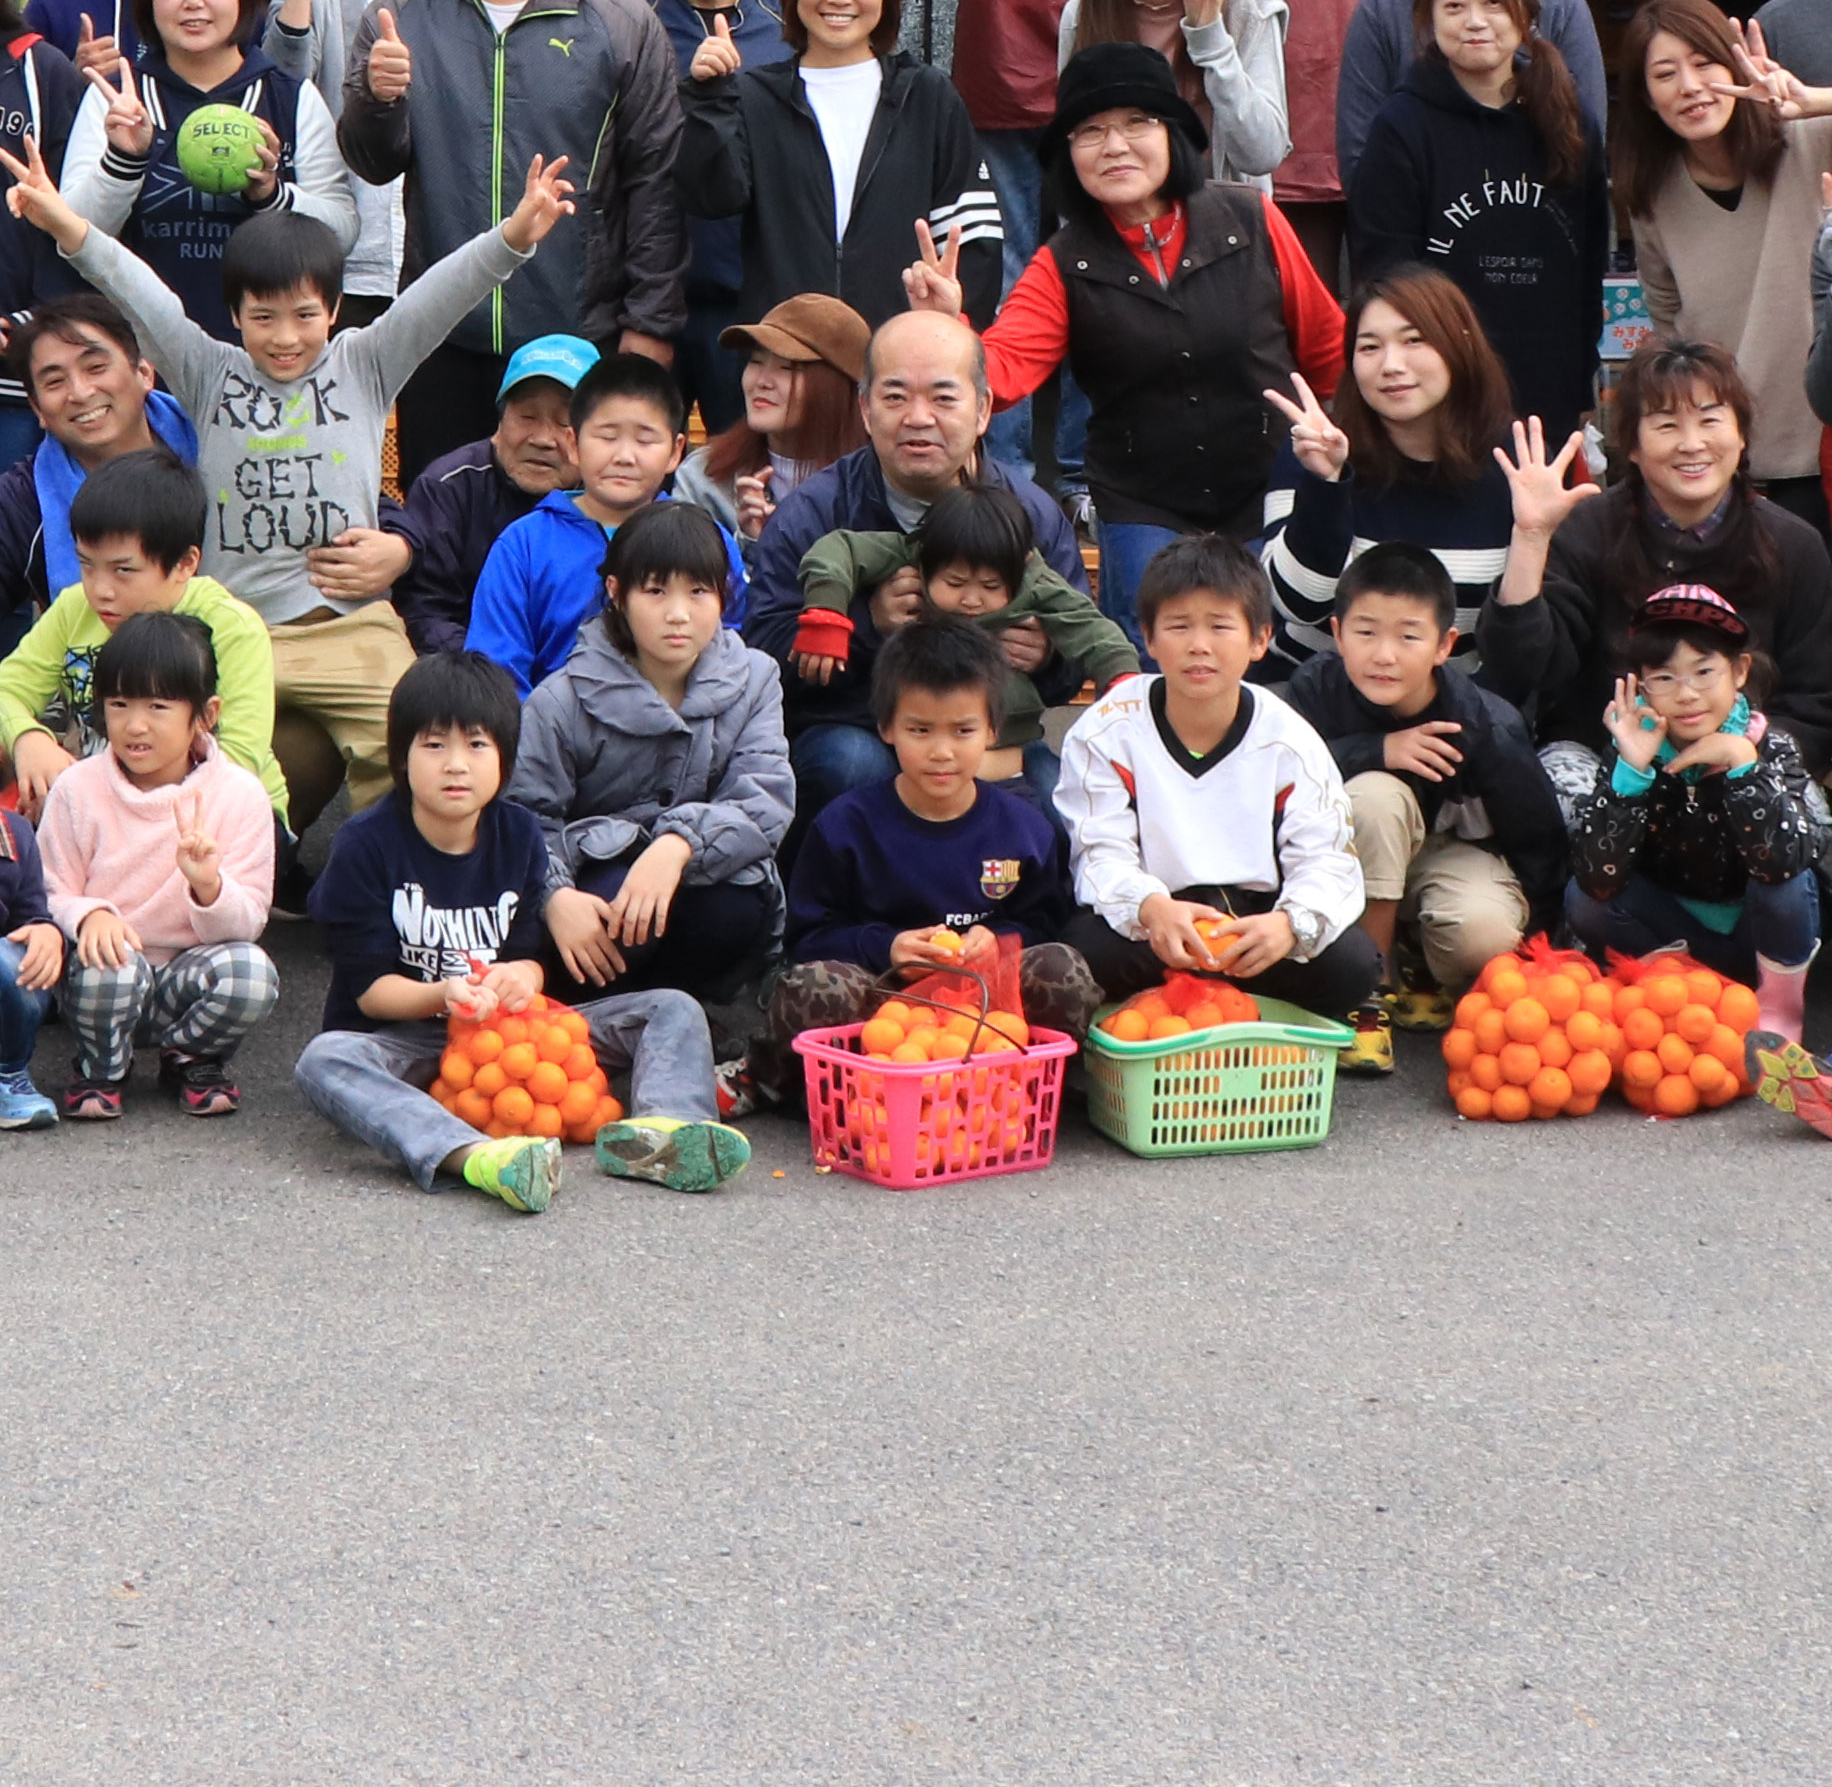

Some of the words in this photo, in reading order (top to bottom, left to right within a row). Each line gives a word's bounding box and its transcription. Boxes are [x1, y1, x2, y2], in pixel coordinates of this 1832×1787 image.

[193, 122, 250, 139] SELECT
[141, 216, 232, 238] karrim
[1426, 237, 1455, 255] IL
[1442, 191, 1481, 229] NE
[1482, 179, 1545, 209] FAUT
[180, 242, 224, 259] RUN
[234, 452, 323, 501] GET
[216, 500, 350, 555] LOUD
